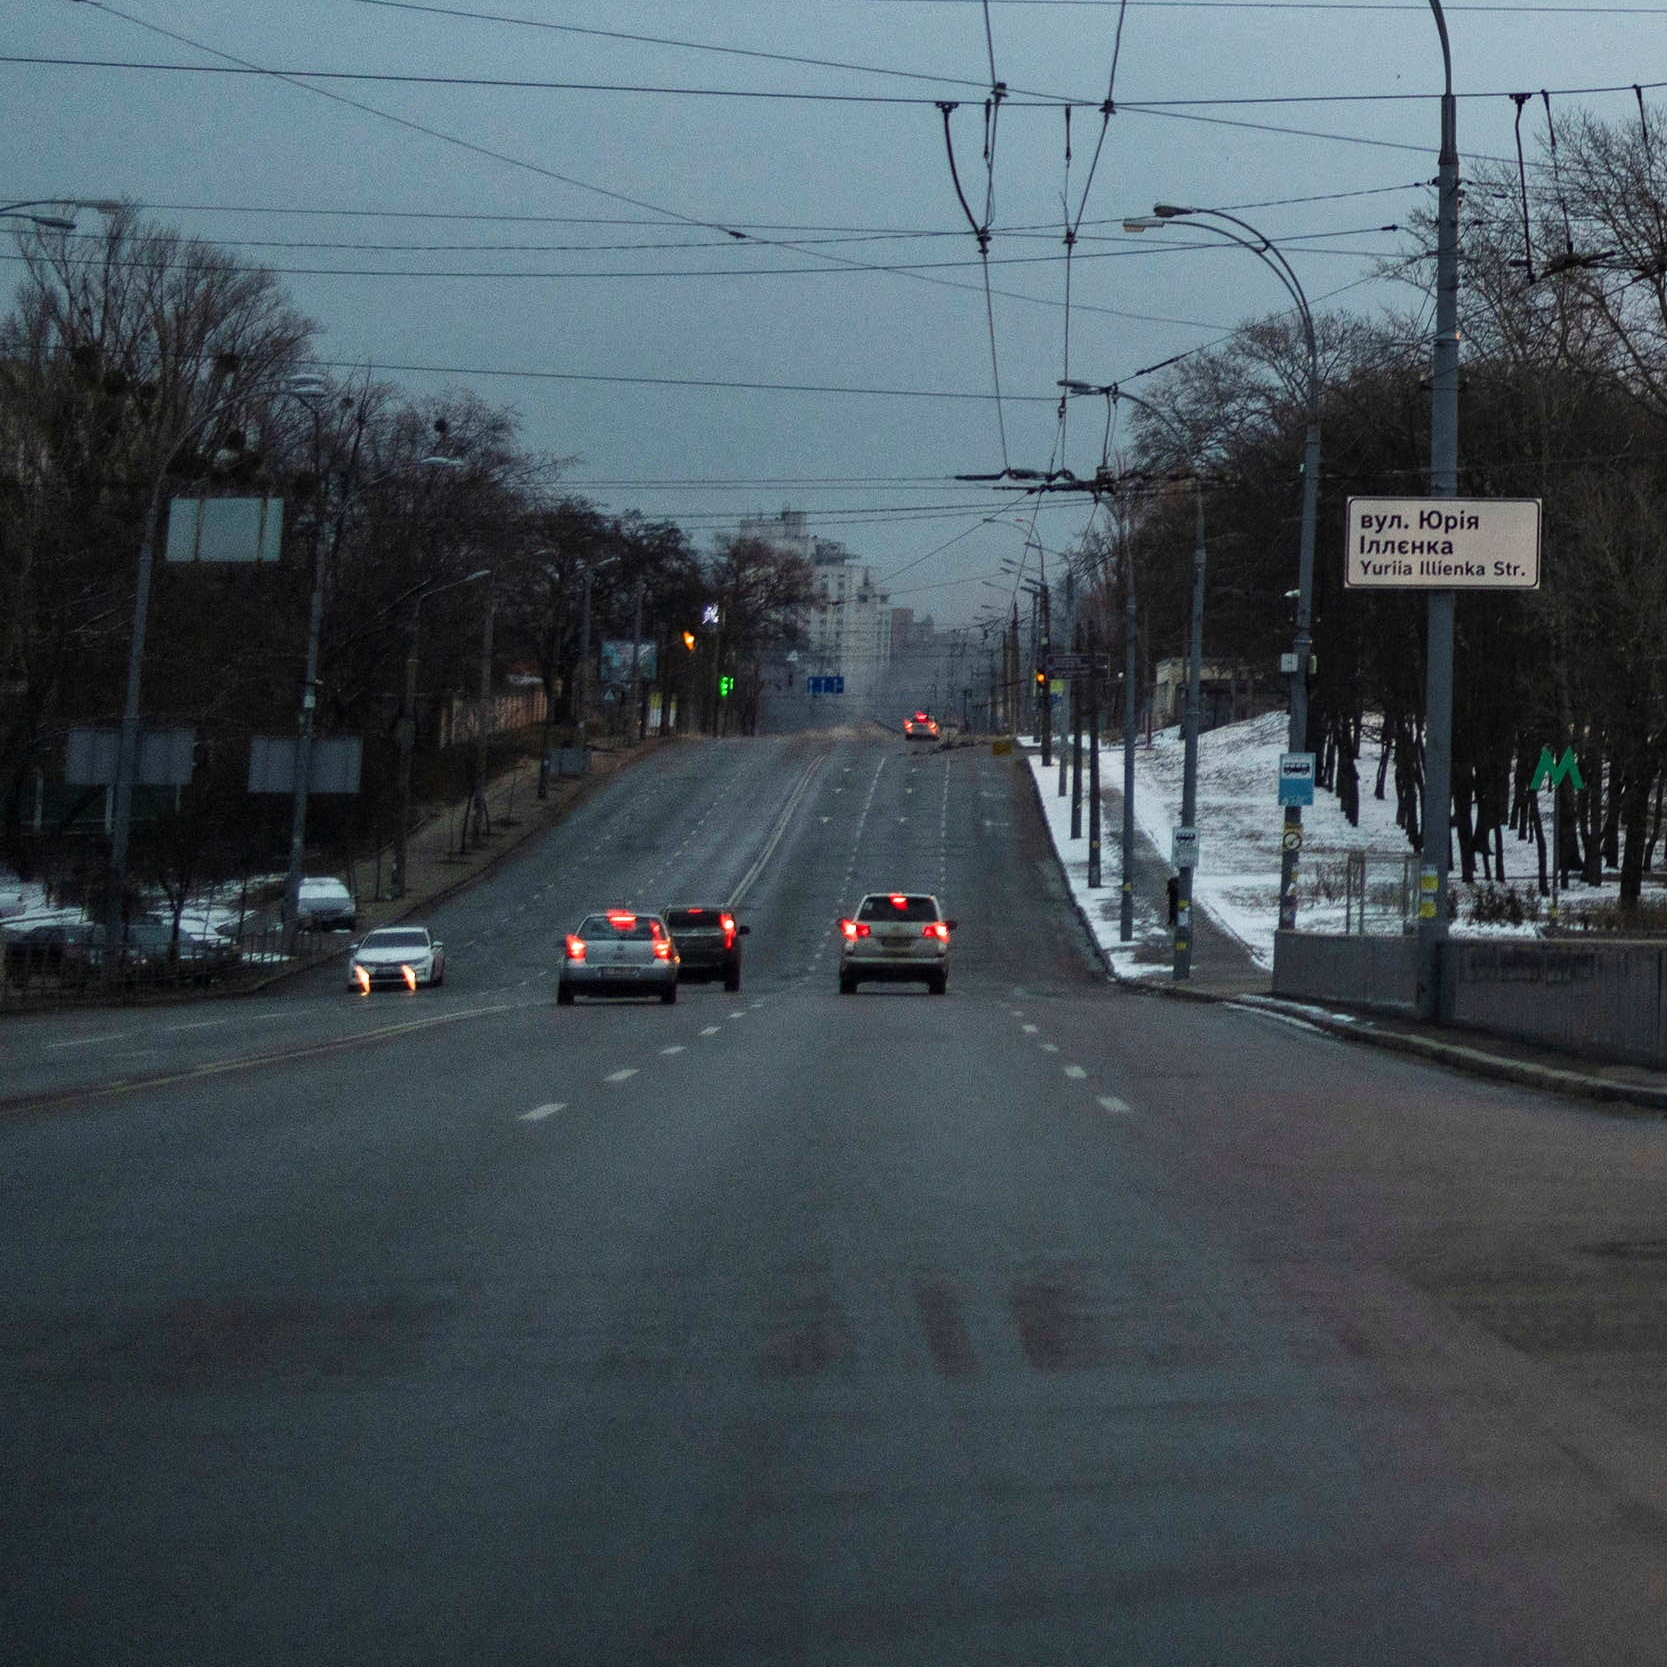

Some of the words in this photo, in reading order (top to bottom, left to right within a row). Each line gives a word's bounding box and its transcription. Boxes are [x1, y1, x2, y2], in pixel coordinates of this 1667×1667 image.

[1360, 514, 1409, 533] вул.
[1419, 510, 1480, 534] Юрія
[1359, 535, 1454, 555] Іллєнка
[1360, 560, 1412, 576] Yuriia
[1420, 560, 1486, 576] Illienka
[1494, 561, 1526, 576] Str.
